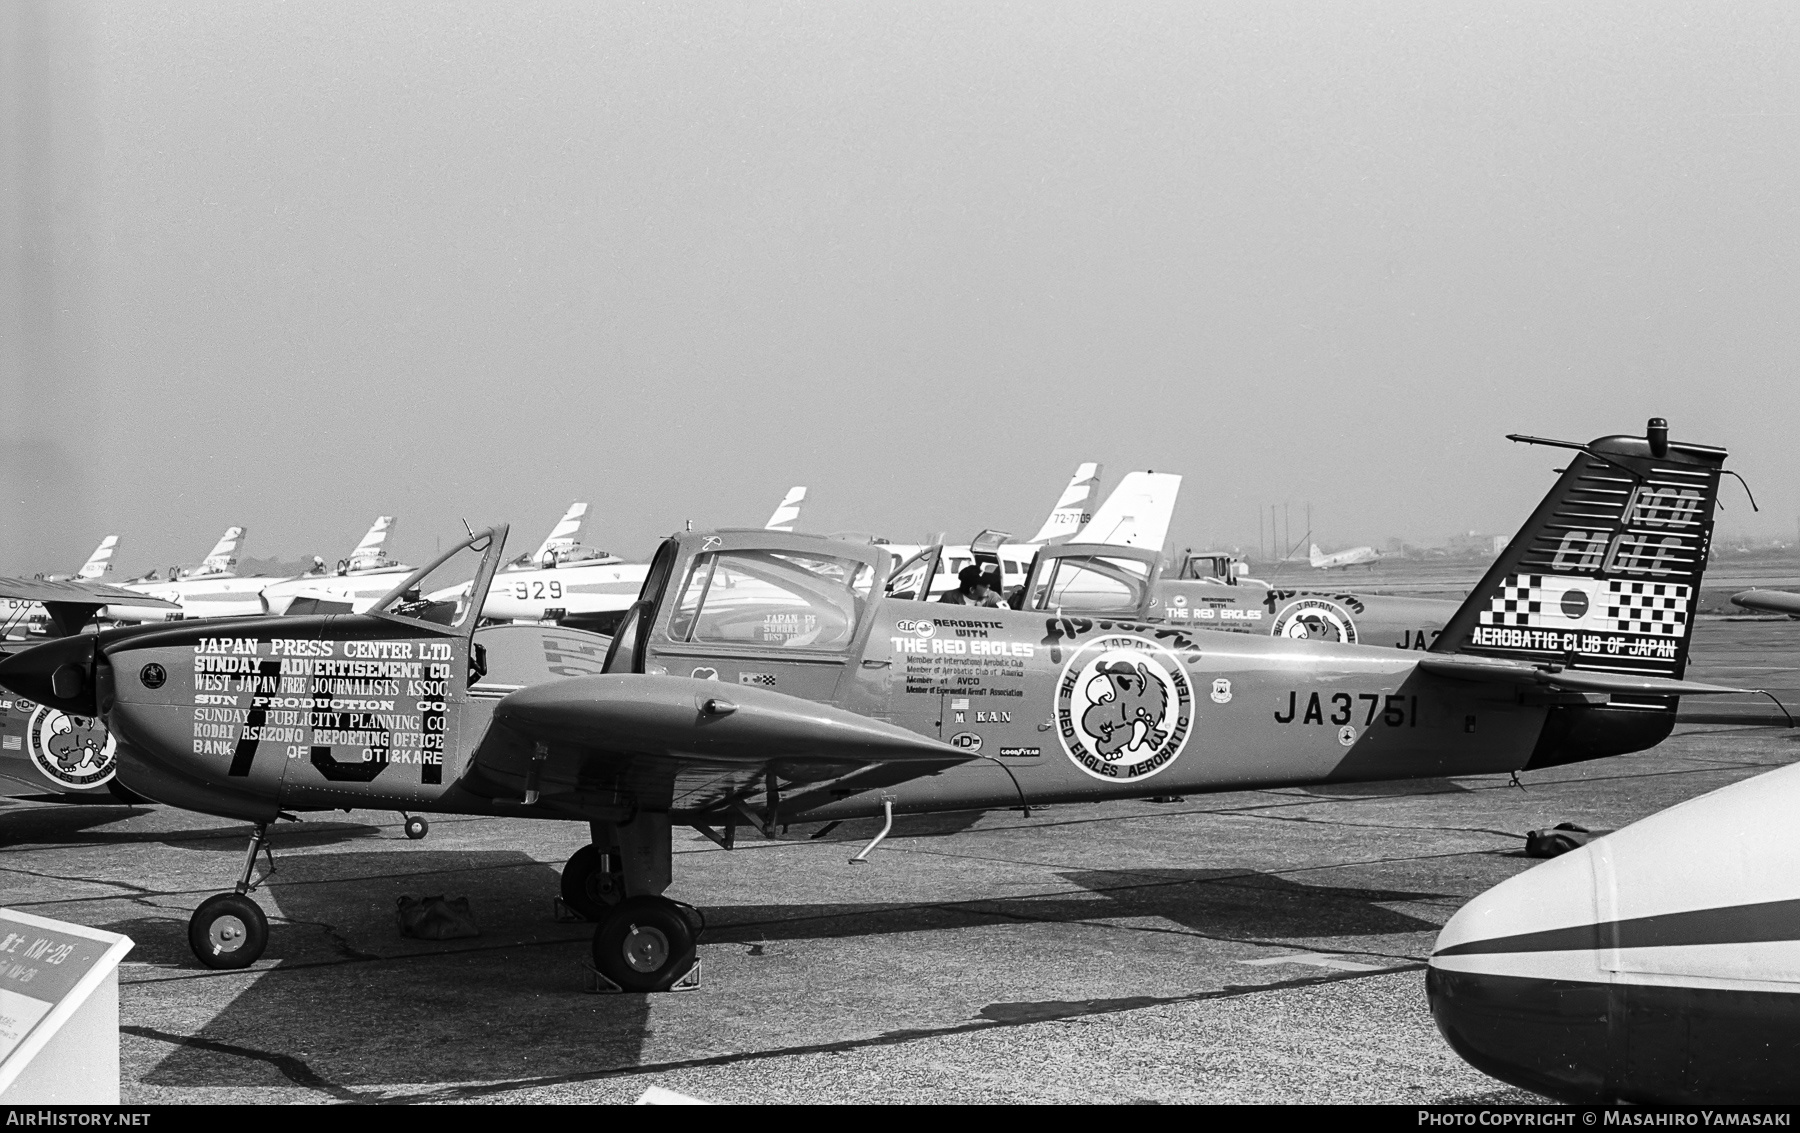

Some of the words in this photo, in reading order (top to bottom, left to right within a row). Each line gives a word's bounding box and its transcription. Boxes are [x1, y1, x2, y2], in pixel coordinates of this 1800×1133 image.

[1054, 514, 1091, 524] 72-7709
[516, 581, 562, 600] 929
[1166, 608, 1189, 618] THE
[1193, 608, 1214, 619] RED
[1220, 609, 1262, 620] EAGLES
[1296, 601, 1334, 612] JAPAN
[764, 614, 798, 623] JAPAN
[933, 619, 1003, 629] AEROBATIC
[956, 629, 988, 638] WITH
[1273, 620, 1286, 636] THE
[194, 638, 258, 655] JAPAN
[270, 639, 333, 656] PRESS
[344, 641, 412, 659] CENTER
[419, 643, 454, 661] LTD.
[891, 637, 927, 653] THE
[932, 639, 966, 655] RED
[970, 640, 1034, 657] EAGLES
[1473, 626, 1558, 650] AEROBATIC
[1563, 633, 1600, 653] CLUB
[1607, 636, 1626, 654] OF
[1629, 638, 1678, 657] JAPAN
[194, 656, 263, 674] SUNDAY
[280, 659, 422, 678] ADVERTISEMENT
[430, 662, 454, 679] CO.
[907, 656, 933, 664] Member
[944, 657, 982, 666] International
[1011, 659, 1023, 667] Club
[907, 676, 932, 684] Member
[957, 677, 980, 685] AVCO
[976, 668, 988, 676] Club
[194, 675, 231, 692] WEST
[236, 675, 276, 693] JAPAN
[281, 677, 306, 694] FREE
[311, 678, 399, 696] JOURNALISTS
[406, 680, 453, 697] ASSOC.
[906, 686, 928, 694] Member
[990, 688, 1023, 697] Association
[1059, 669, 1081, 699] THE
[1171, 668, 1190, 706] TEAM
[194, 694, 238, 706] SUN
[253, 695, 395, 710] PRODUCTION
[416, 701, 450, 712] CO.
[1274, 691, 1417, 728] JA3751
[35, 707, 50, 724] THE
[194, 708, 250, 723] SUNDAY
[265, 710, 342, 728] PUBLICITY
[349, 713, 420, 730] PLANNING
[427, 716, 450, 732] CO.
[976, 711, 1012, 723] KAN
[1059, 709, 1075, 738] RED
[32, 729, 41, 749] RED
[242, 726, 303, 743] ASAZONO
[314, 729, 389, 747] REPORTING
[393, 732, 444, 749] OFFICE
[960, 736, 972, 747] D
[193, 740, 233, 755] BANK
[287, 746, 308, 758] OF
[1001, 748, 1040, 756] GOODYEAR
[1128, 716, 1189, 778] AEROBATIC
[1070, 741, 1118, 777] EAGLES
[37, 755, 74, 783] EAGLES
[23, 938, 74, 965] KM-2B
